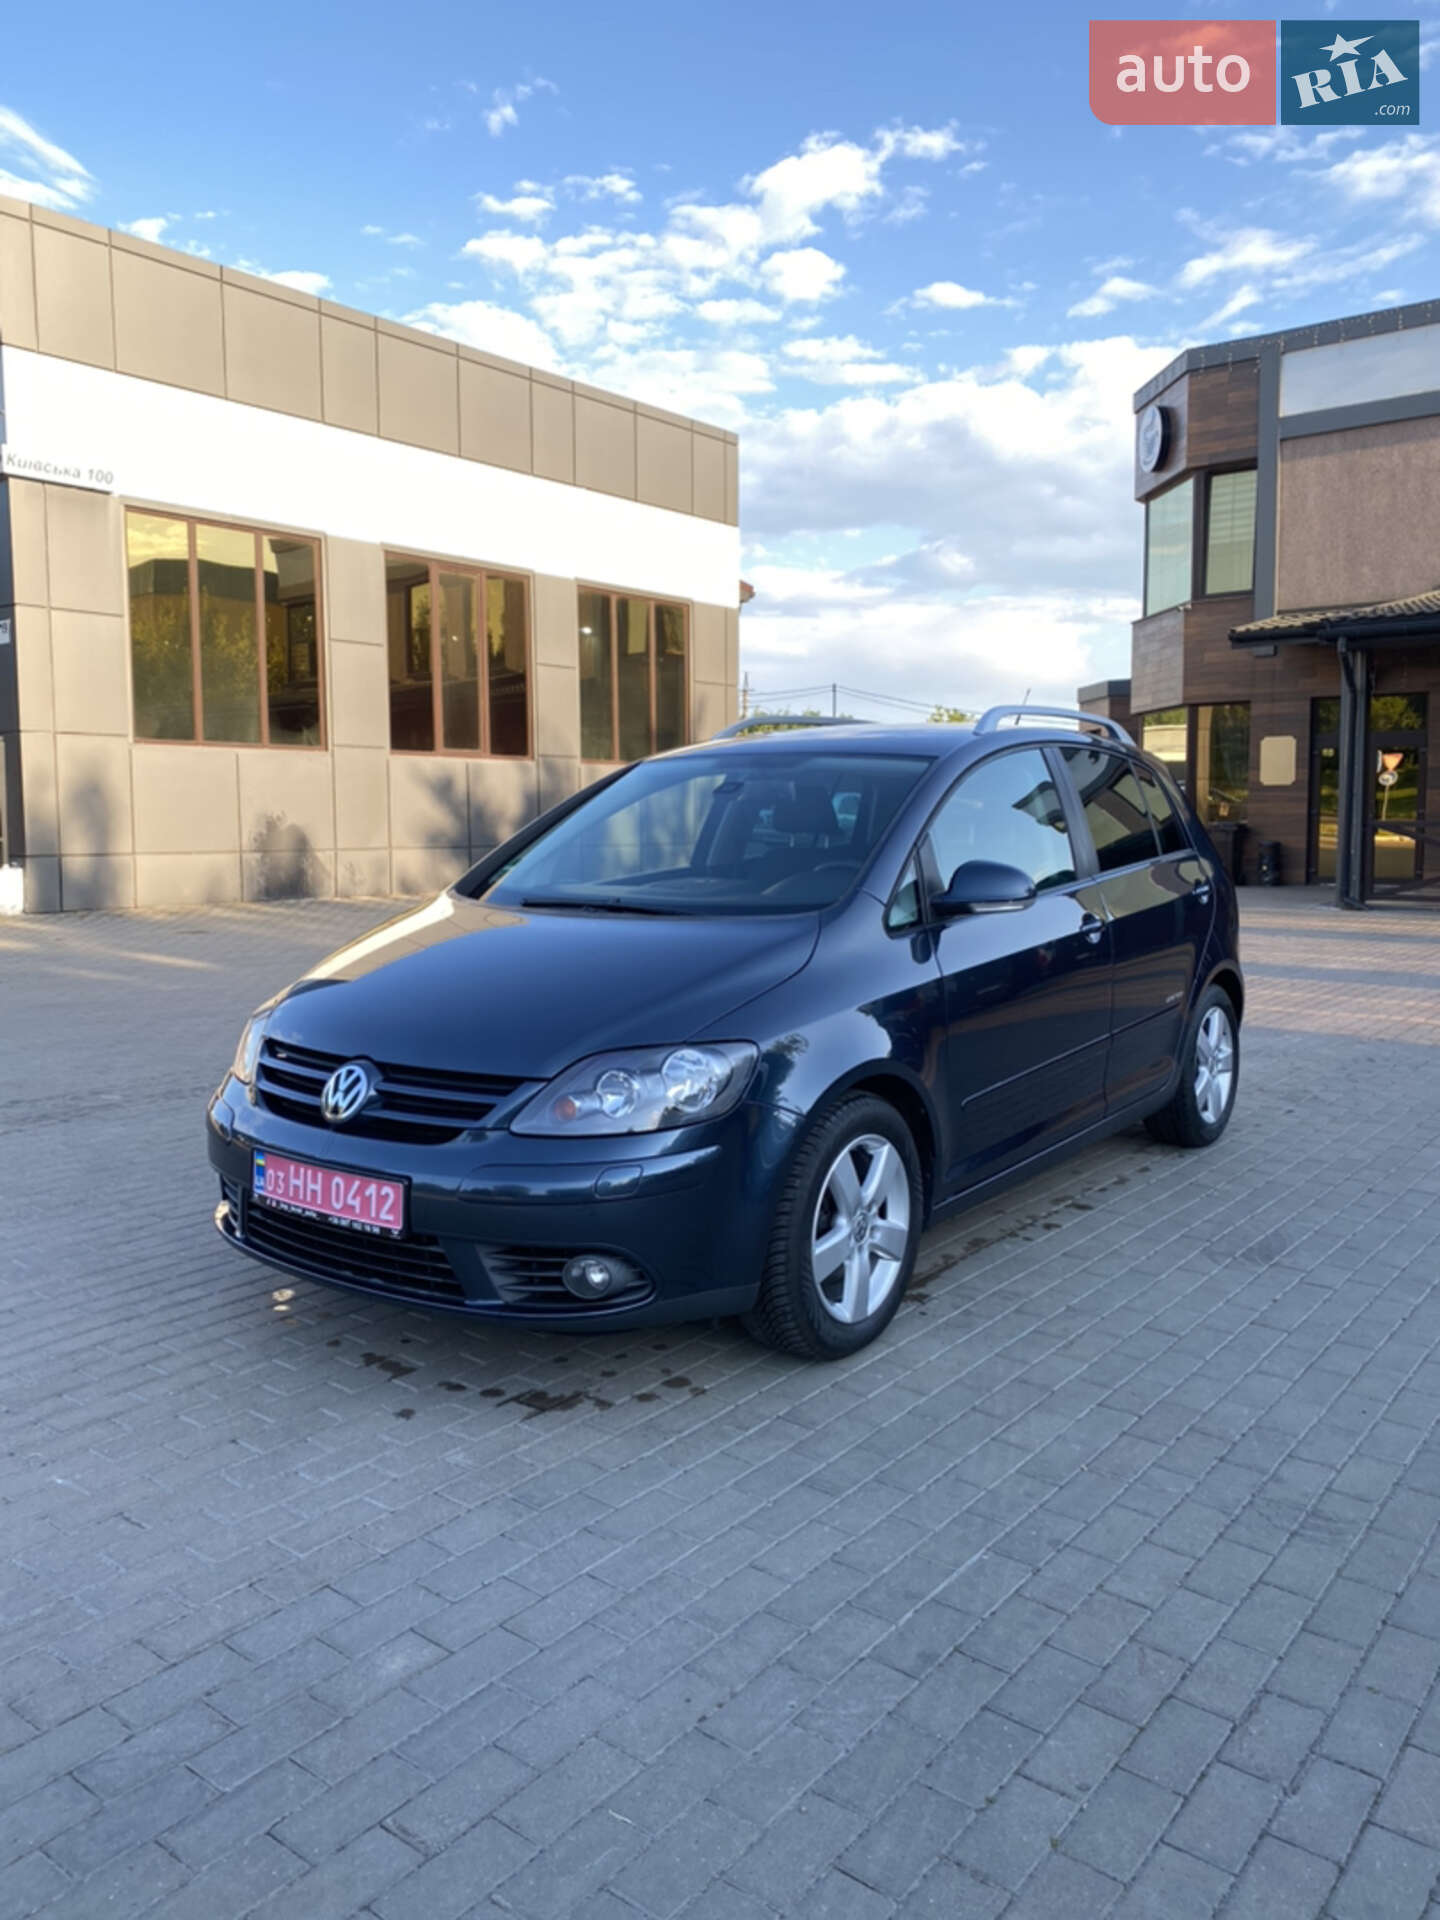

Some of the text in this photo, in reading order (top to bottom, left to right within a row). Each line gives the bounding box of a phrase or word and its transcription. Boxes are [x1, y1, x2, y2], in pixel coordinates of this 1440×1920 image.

[88, 468, 114, 485] 100
[266, 1168, 285, 1195] 03
[330, 1175, 396, 1222] 0412
